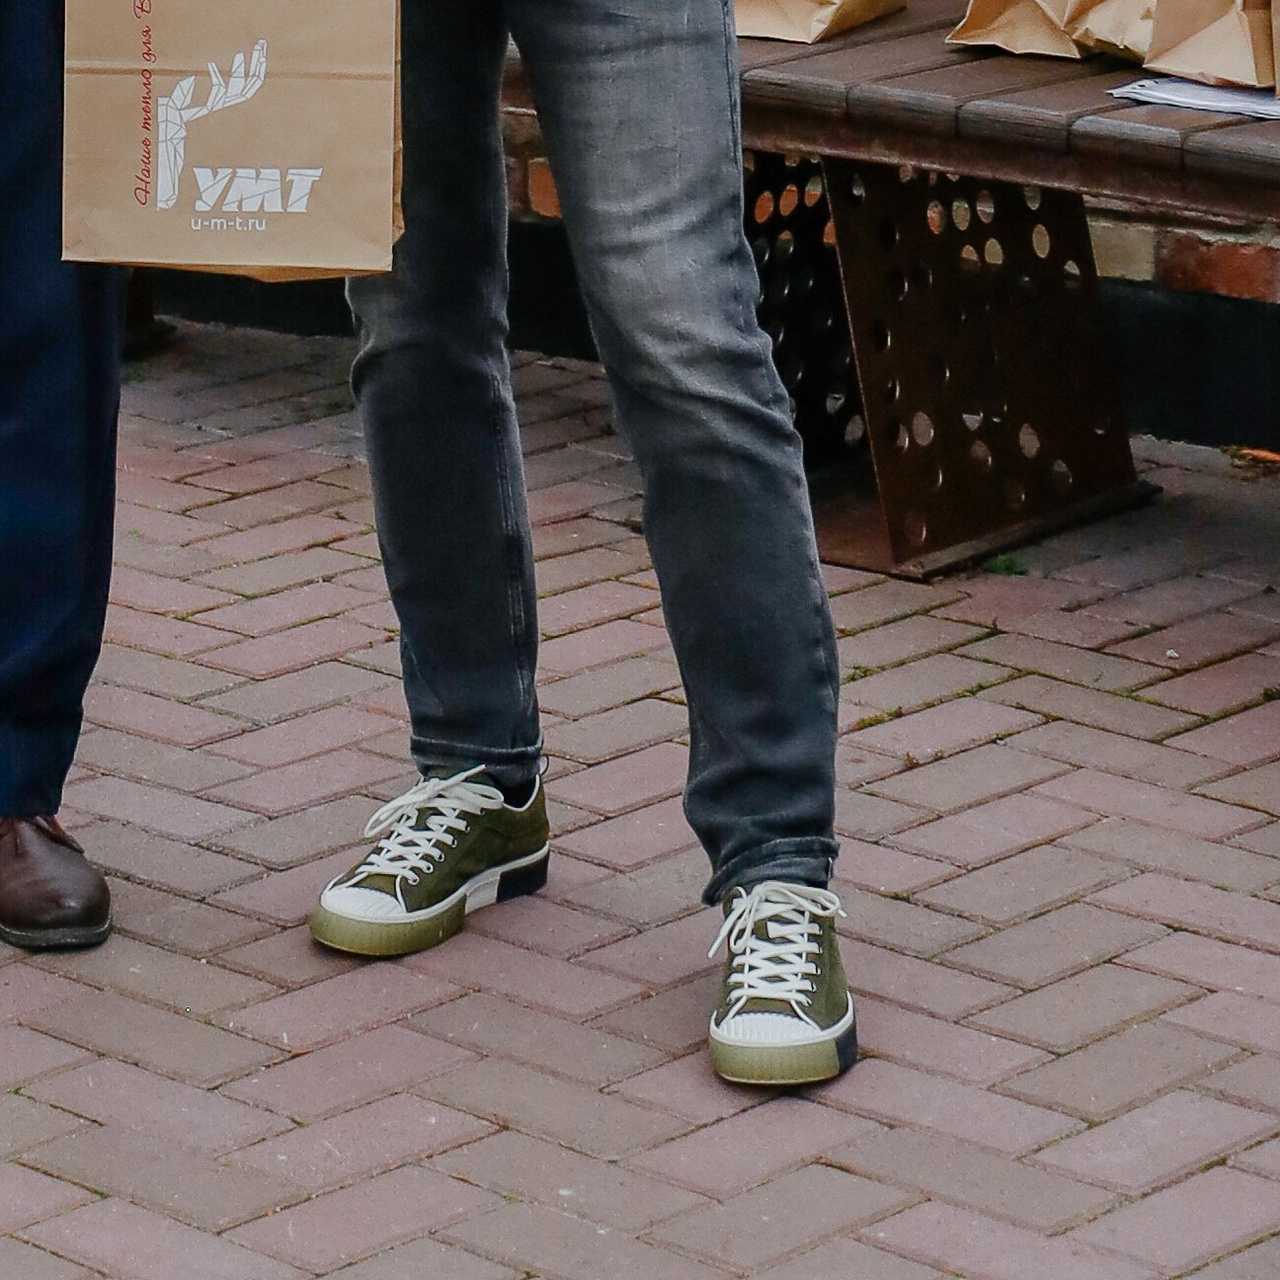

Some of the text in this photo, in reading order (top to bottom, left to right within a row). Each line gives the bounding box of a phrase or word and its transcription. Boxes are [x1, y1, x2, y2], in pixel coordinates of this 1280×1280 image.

[141, 25, 157, 64] для
[141, 69, 152, 132] тепло
[133, 137, 151, 206] Наше
[190, 216, 266, 231] u-m-t.ru
